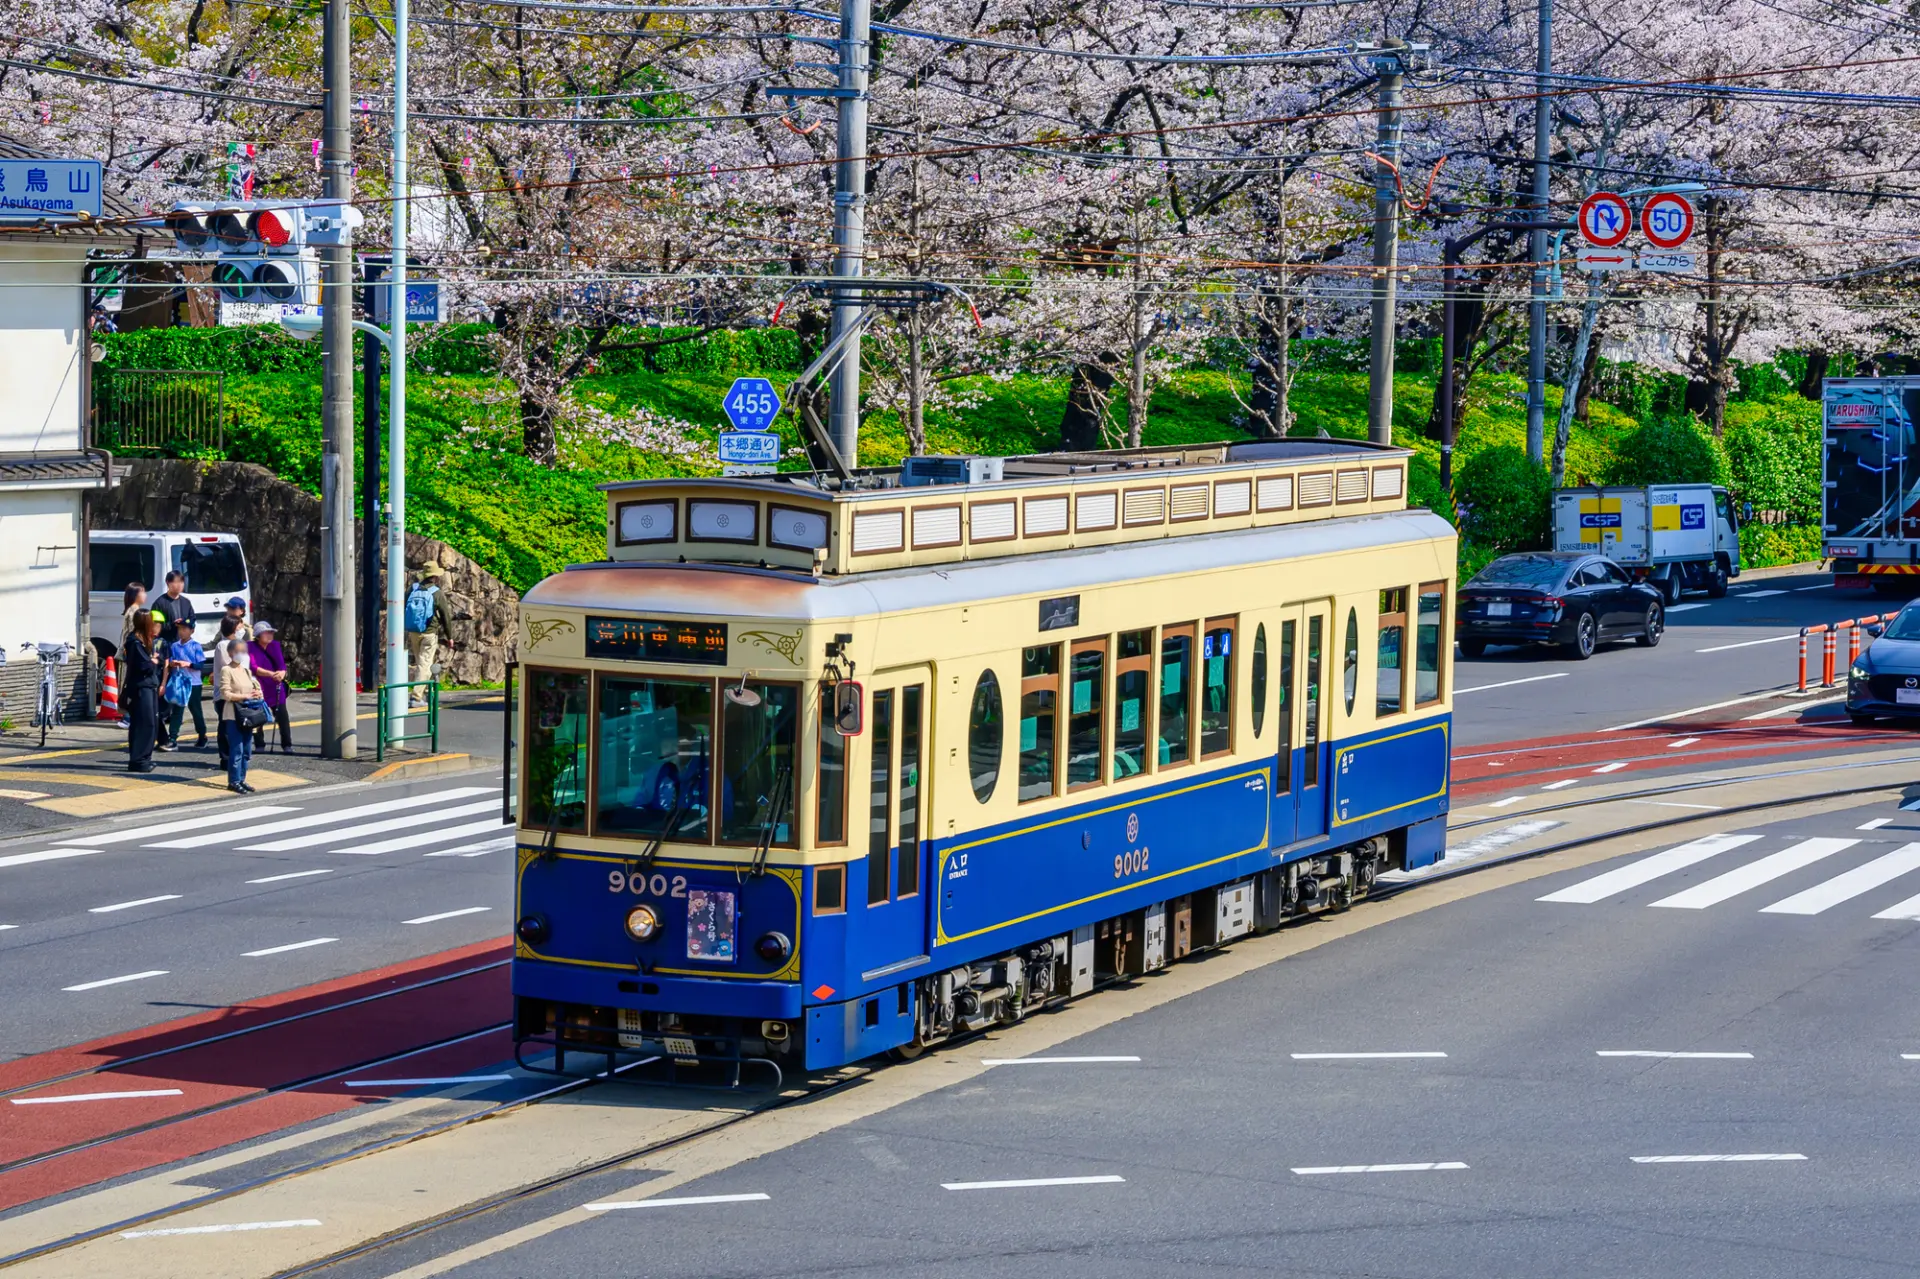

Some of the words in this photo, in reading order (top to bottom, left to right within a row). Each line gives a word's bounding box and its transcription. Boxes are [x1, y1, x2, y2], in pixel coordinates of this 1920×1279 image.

[0, 195, 74, 211] Asukayama
[1653, 208, 1682, 233] 50
[1644, 254, 1690, 267] ここから
[405, 305, 435, 315] BAN
[731, 393, 772, 415] 455
[1829, 403, 1880, 417] MARUSHIMA
[722, 437, 775, 451] 本郷通り
[1582, 514, 1620, 526] CSP
[1682, 507, 1704, 526] CSP
[949, 853, 968, 871] 入口
[1114, 846, 1149, 879] 9002
[608, 870, 687, 899] 9002
[707, 901, 717, 942] さくら号
